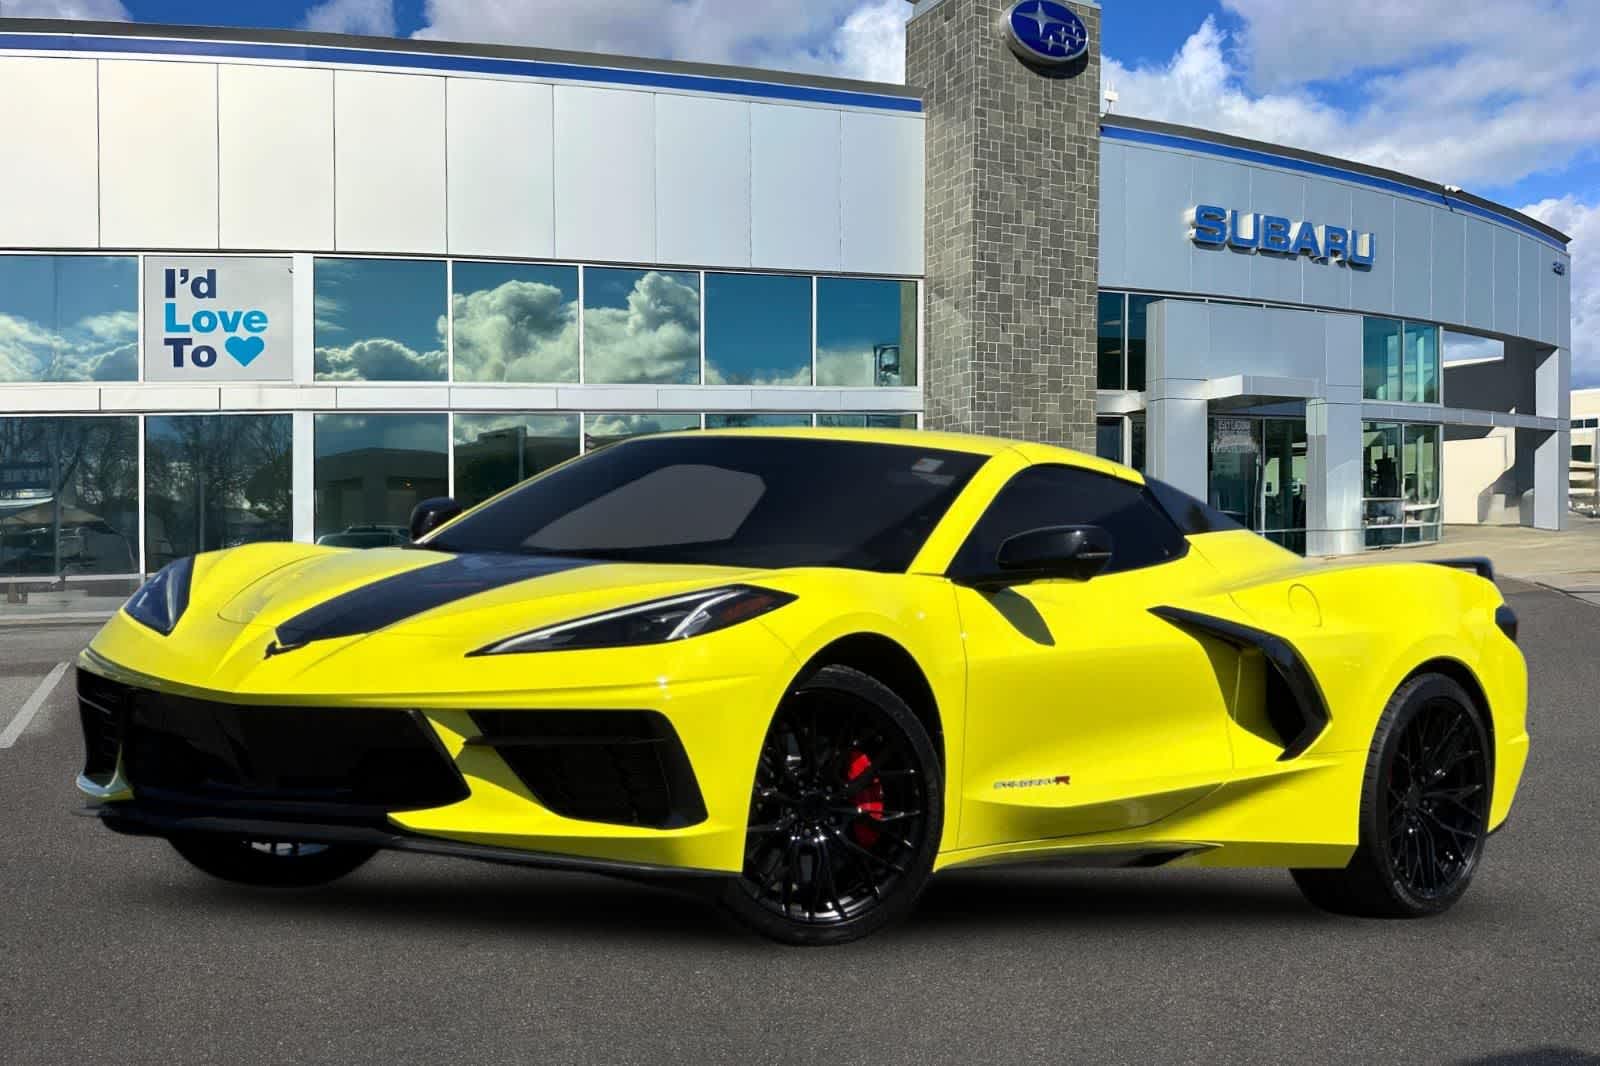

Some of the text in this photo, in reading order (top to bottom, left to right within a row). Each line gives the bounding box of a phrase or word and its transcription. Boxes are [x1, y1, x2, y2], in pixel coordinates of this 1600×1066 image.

[1193, 204, 1376, 267] SUBARU
[165, 268, 217, 299] I'd
[165, 303, 269, 333] Love
[164, 337, 217, 368] To
